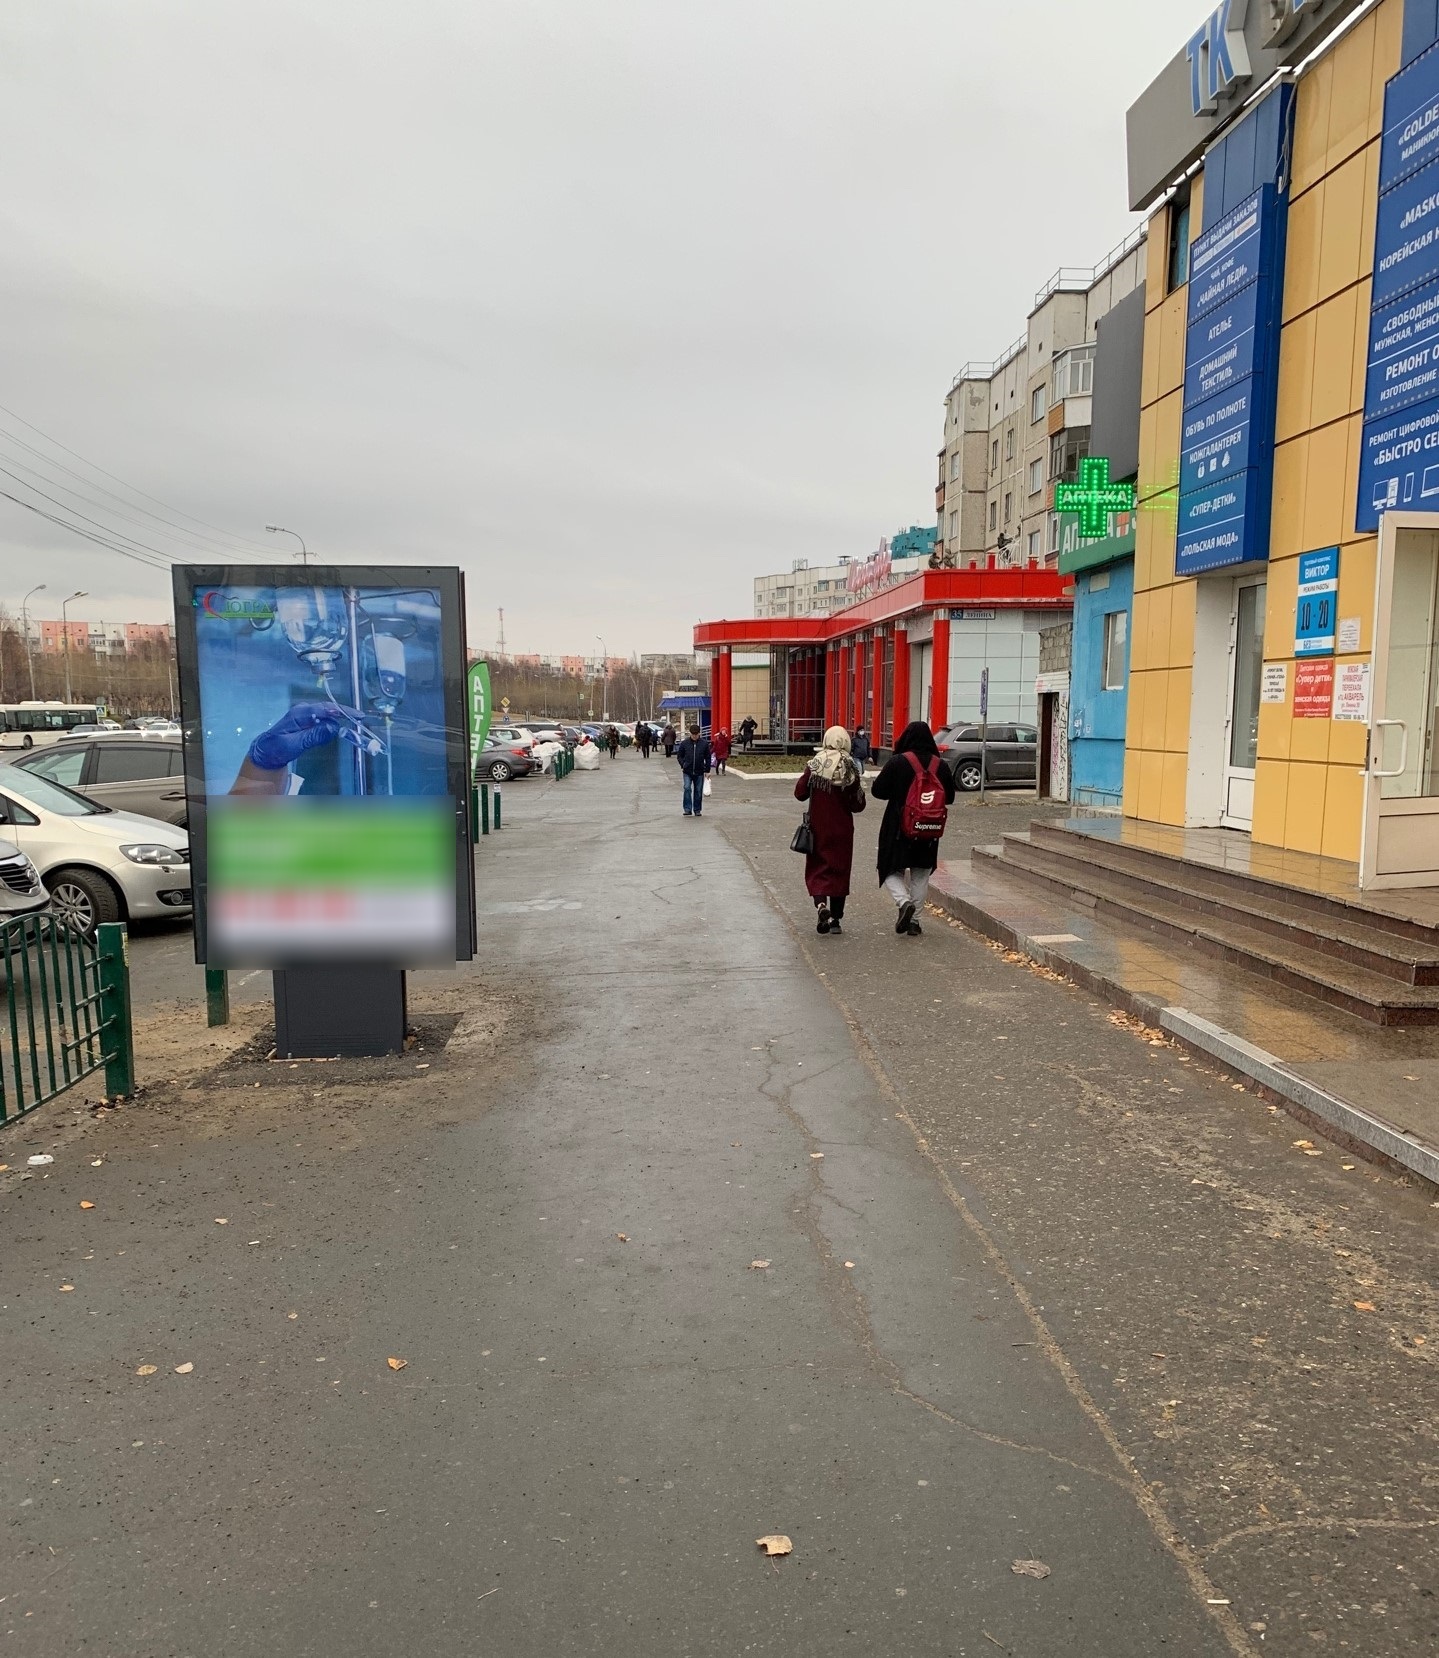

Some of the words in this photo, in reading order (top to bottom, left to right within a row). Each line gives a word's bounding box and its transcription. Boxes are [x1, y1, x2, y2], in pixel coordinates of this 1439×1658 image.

[1186, 0, 1247, 117] ТК
[1194, 238, 1210, 258] ПУНКТ
[1210, 221, 1232, 245] ВЫДАЧИ
[1233, 199, 1258, 226] ЗАКАЗОВ
[1379, 230, 1433, 272] КОРЕЙСКАЯ
[1208, 316, 1232, 341] АТЕЛЬЕ
[1374, 326, 1413, 352] МУЖСКАЯ,
[1199, 344, 1238, 381] ДОМАШНИЙ
[1385, 348, 1430, 381] РЕМОНТ
[1201, 366, 1233, 392] ТЕКСТИЛЬ
[1380, 368, 1438, 401] ИЗГОТОВЛЕНИЕ
[1185, 419, 1205, 438] ОБУВЬ
[1206, 413, 1215, 427] ПО
[1216, 396, 1246, 423] ПОЛНОТЕ
[1189, 431, 1242, 464] КОЖГАЛАНТЕРЕЯ
[1369, 427, 1399, 447] РЕМОНТ
[1373, 437, 1421, 466] «БЫСТРО
[1424, 431, 1439, 449] СЕ
[1062, 490, 1128, 504] АПТЕКА
[1189, 492, 1237, 518] «СУПЕР-ДЕТКИ»
[1181, 537, 1215, 557] «ПОЛЬСКАЯ
[1216, 532, 1239, 548] МОДА»
[1304, 564, 1330, 579] ВИКТОР
[951, 610, 963, 618] 35
[1301, 602, 1311, 630] 10
[1318, 600, 1329, 629] 20
[915, 821, 942, 831] Supreme
